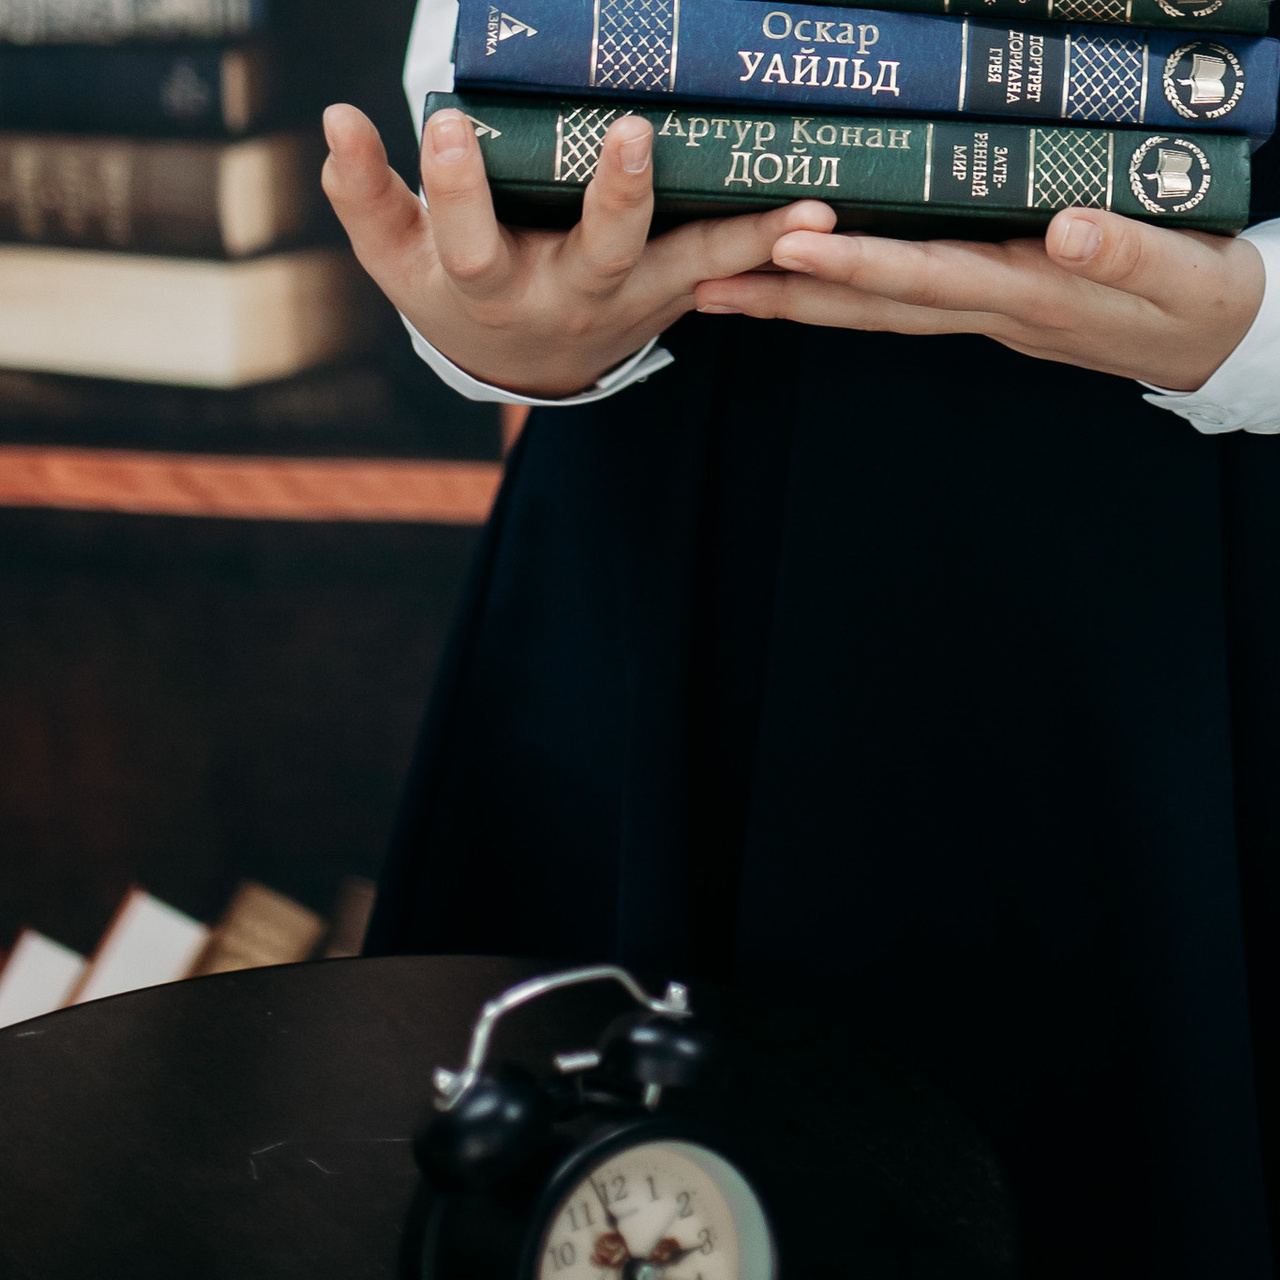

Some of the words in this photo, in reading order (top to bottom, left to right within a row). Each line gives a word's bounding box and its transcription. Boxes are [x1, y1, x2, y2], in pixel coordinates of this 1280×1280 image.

[485, 5, 499, 57] АЗБУКА
[762, 11, 880, 54] Оскар
[738, 47, 901, 97] УАЙЛЬД
[988, 47, 1004, 84] ГРЕЯ
[1006, 29, 1025, 104] ДОРИАНА
[1027, 35, 1044, 103] ПОРТРЕТ
[659, 110, 776, 150] Артур
[790, 116, 911, 150] Конан
[724, 148, 842, 188] ДОЙЛ
[952, 144, 967, 181] МИР
[971, 132, 989, 198] РЯННЫЙ
